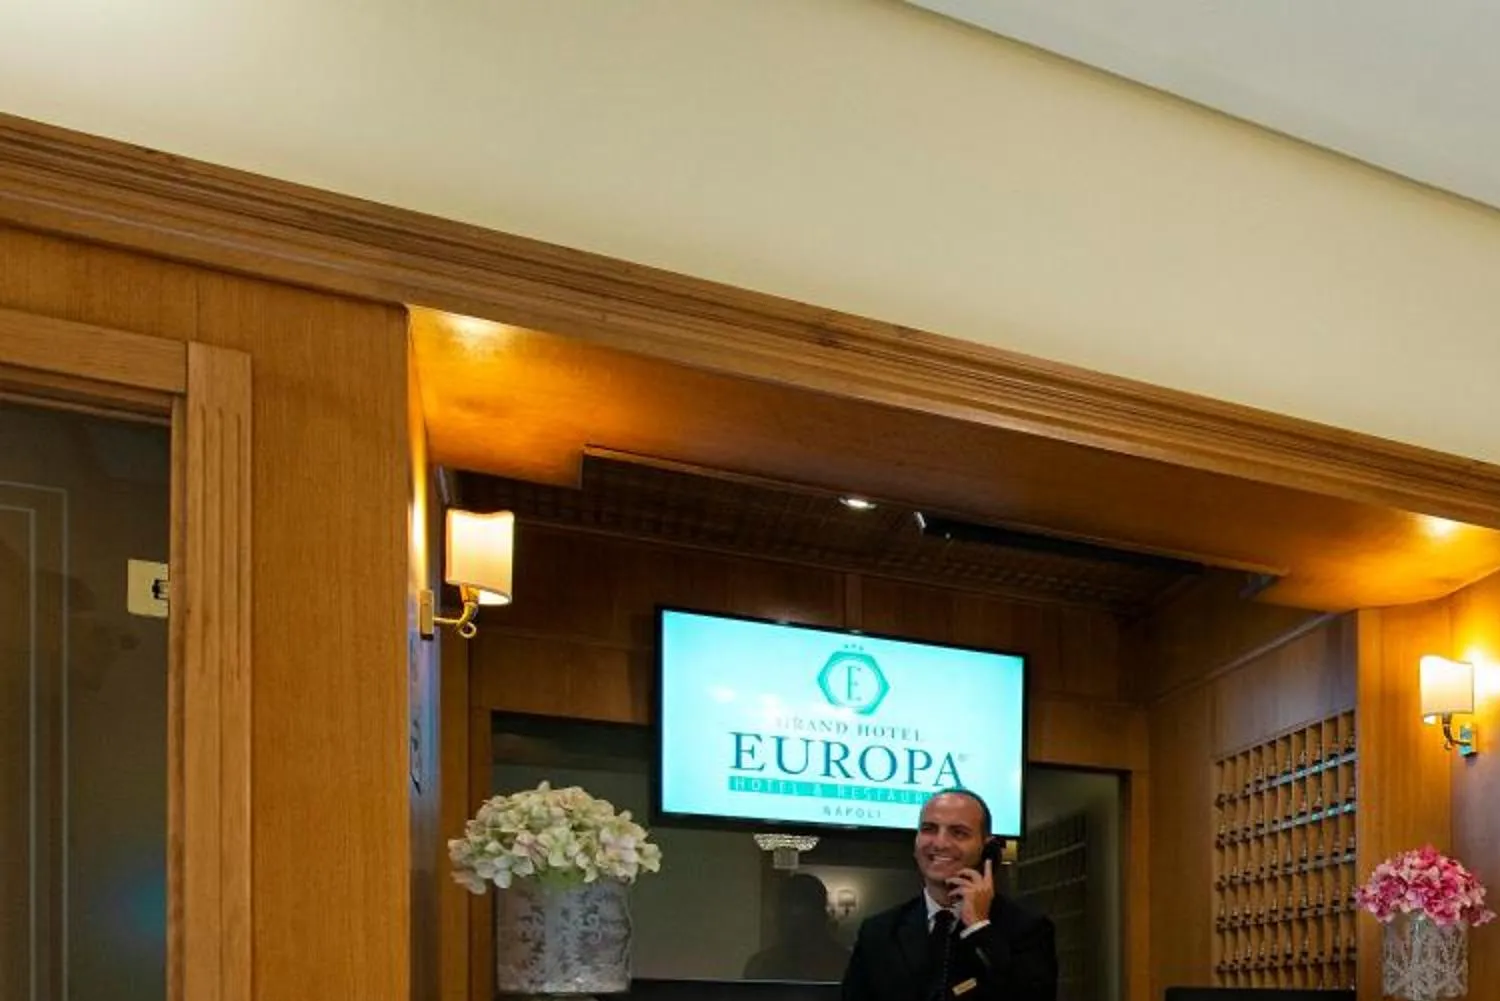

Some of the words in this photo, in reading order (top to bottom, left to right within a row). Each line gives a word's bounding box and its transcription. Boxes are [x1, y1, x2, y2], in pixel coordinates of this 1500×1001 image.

[857, 722, 922, 741] HOTEL
[729, 731, 966, 789] EUROPA
[735, 777, 799, 796] HOTEL
[837, 784, 930, 804] RESTAUR
[823, 805, 882, 819] NAPOLI
